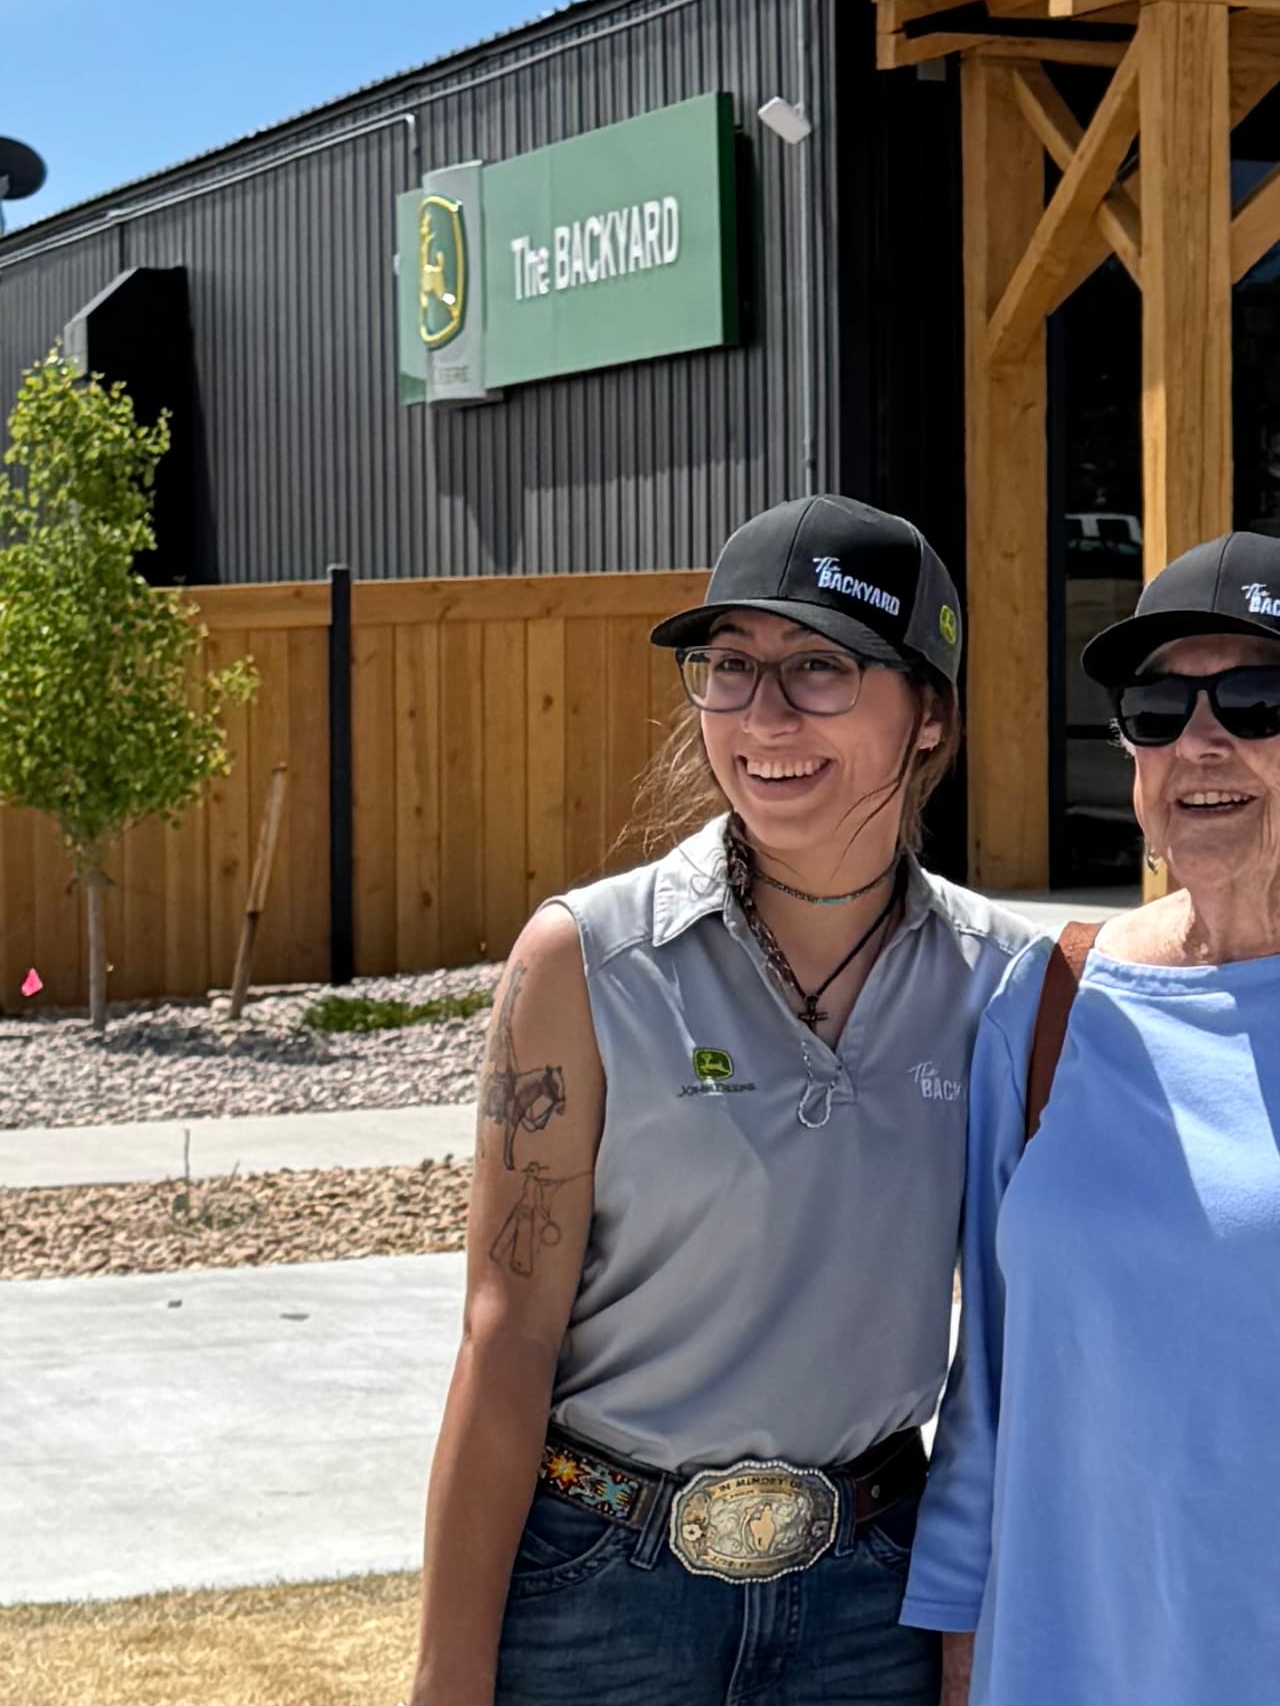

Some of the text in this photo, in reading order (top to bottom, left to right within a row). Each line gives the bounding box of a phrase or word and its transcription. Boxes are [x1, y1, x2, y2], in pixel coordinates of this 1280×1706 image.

[511, 196, 679, 300] The BACKYARD
[818, 570, 900, 616] BACKYARD
[906, 1061, 939, 1083] The
